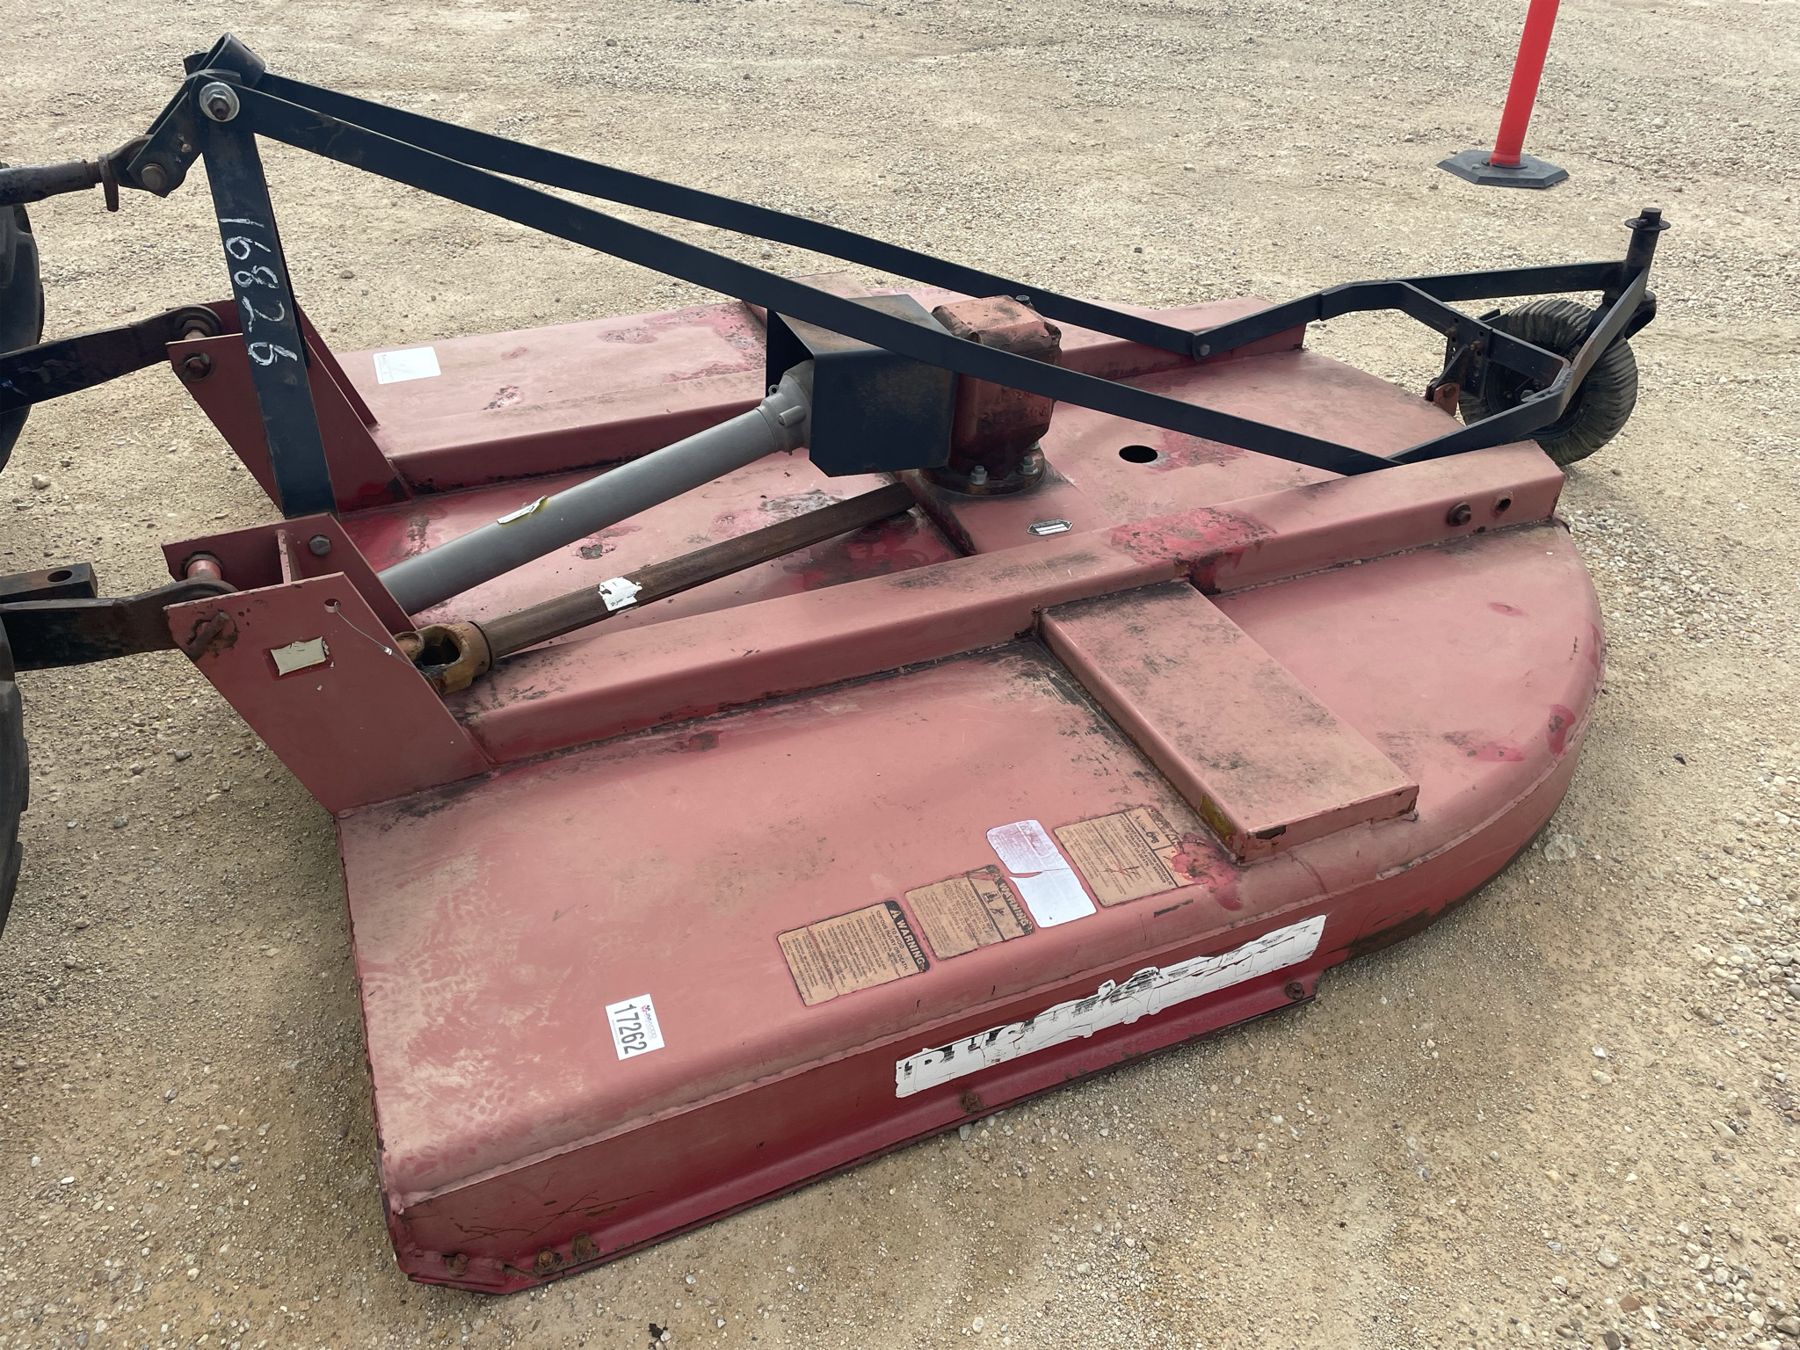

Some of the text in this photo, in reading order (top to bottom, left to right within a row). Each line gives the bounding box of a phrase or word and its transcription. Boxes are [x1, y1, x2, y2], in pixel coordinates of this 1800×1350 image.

[219, 218, 298, 367] 16826
[999, 883, 1030, 927] WARNING
[897, 919, 926, 966] WARNING
[613, 1003, 648, 1055] 17262
